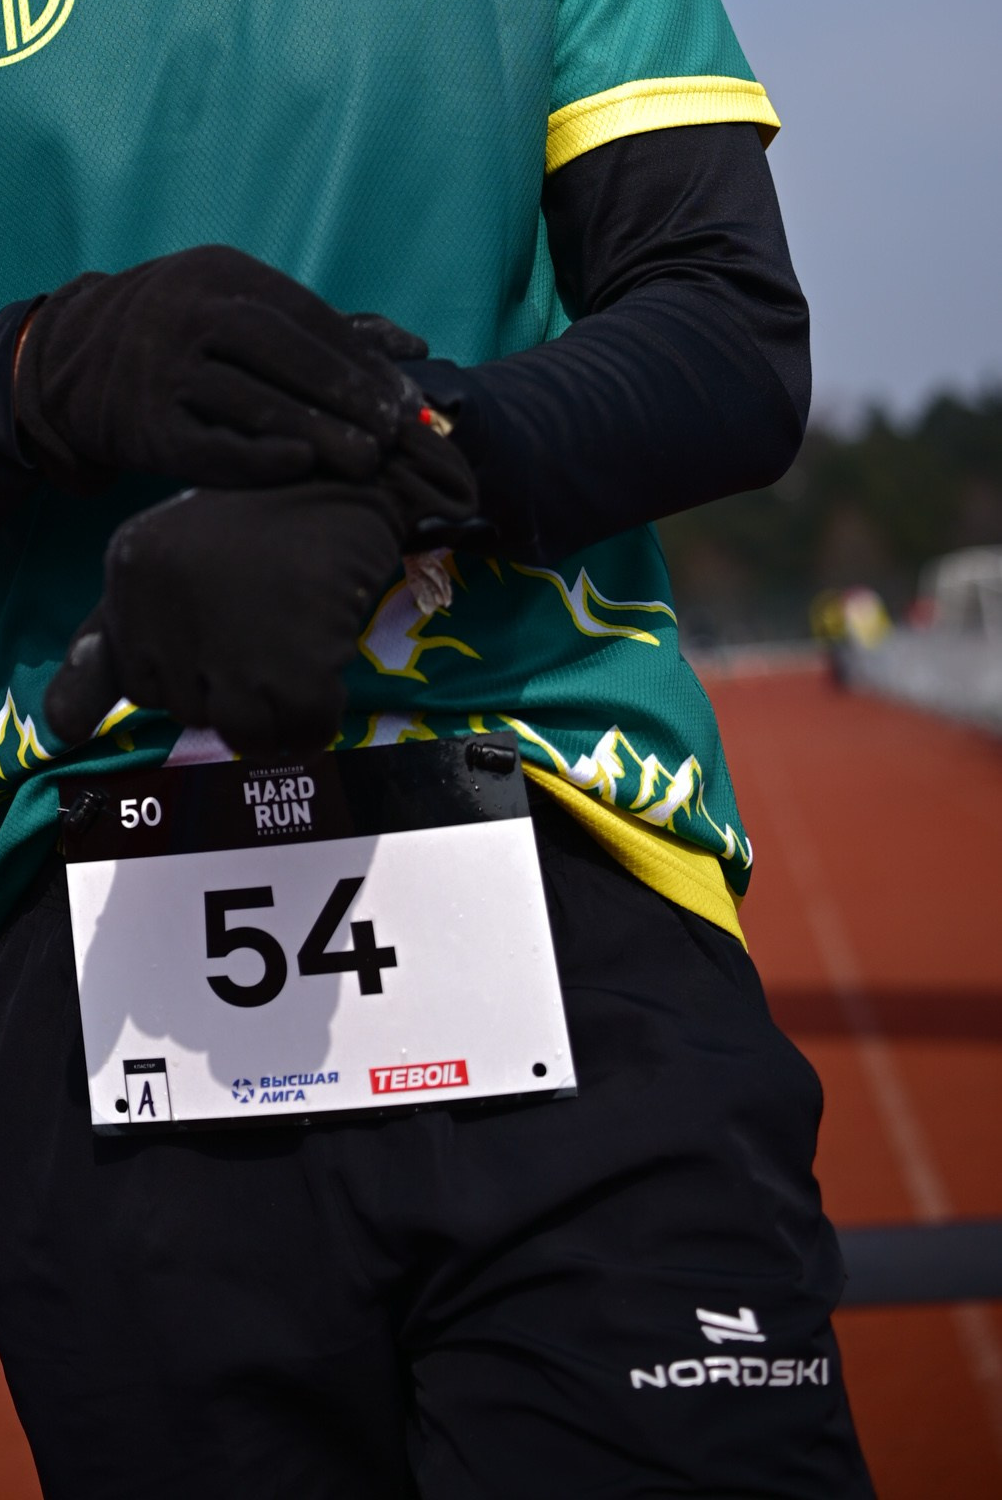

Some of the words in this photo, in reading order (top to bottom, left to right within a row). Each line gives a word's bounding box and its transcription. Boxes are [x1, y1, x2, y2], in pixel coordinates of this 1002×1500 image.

[243, 776, 315, 805] HARD
[119, 796, 163, 829] 50
[254, 801, 311, 828] RUN
[203, 876, 399, 1009] 54
[259, 1071, 340, 1089] ВЫСШАЯ
[373, 1063, 463, 1092] TEBOIL
[258, 1089, 306, 1105] ЛИГА
[630, 1356, 830, 1390] NORDSKI
